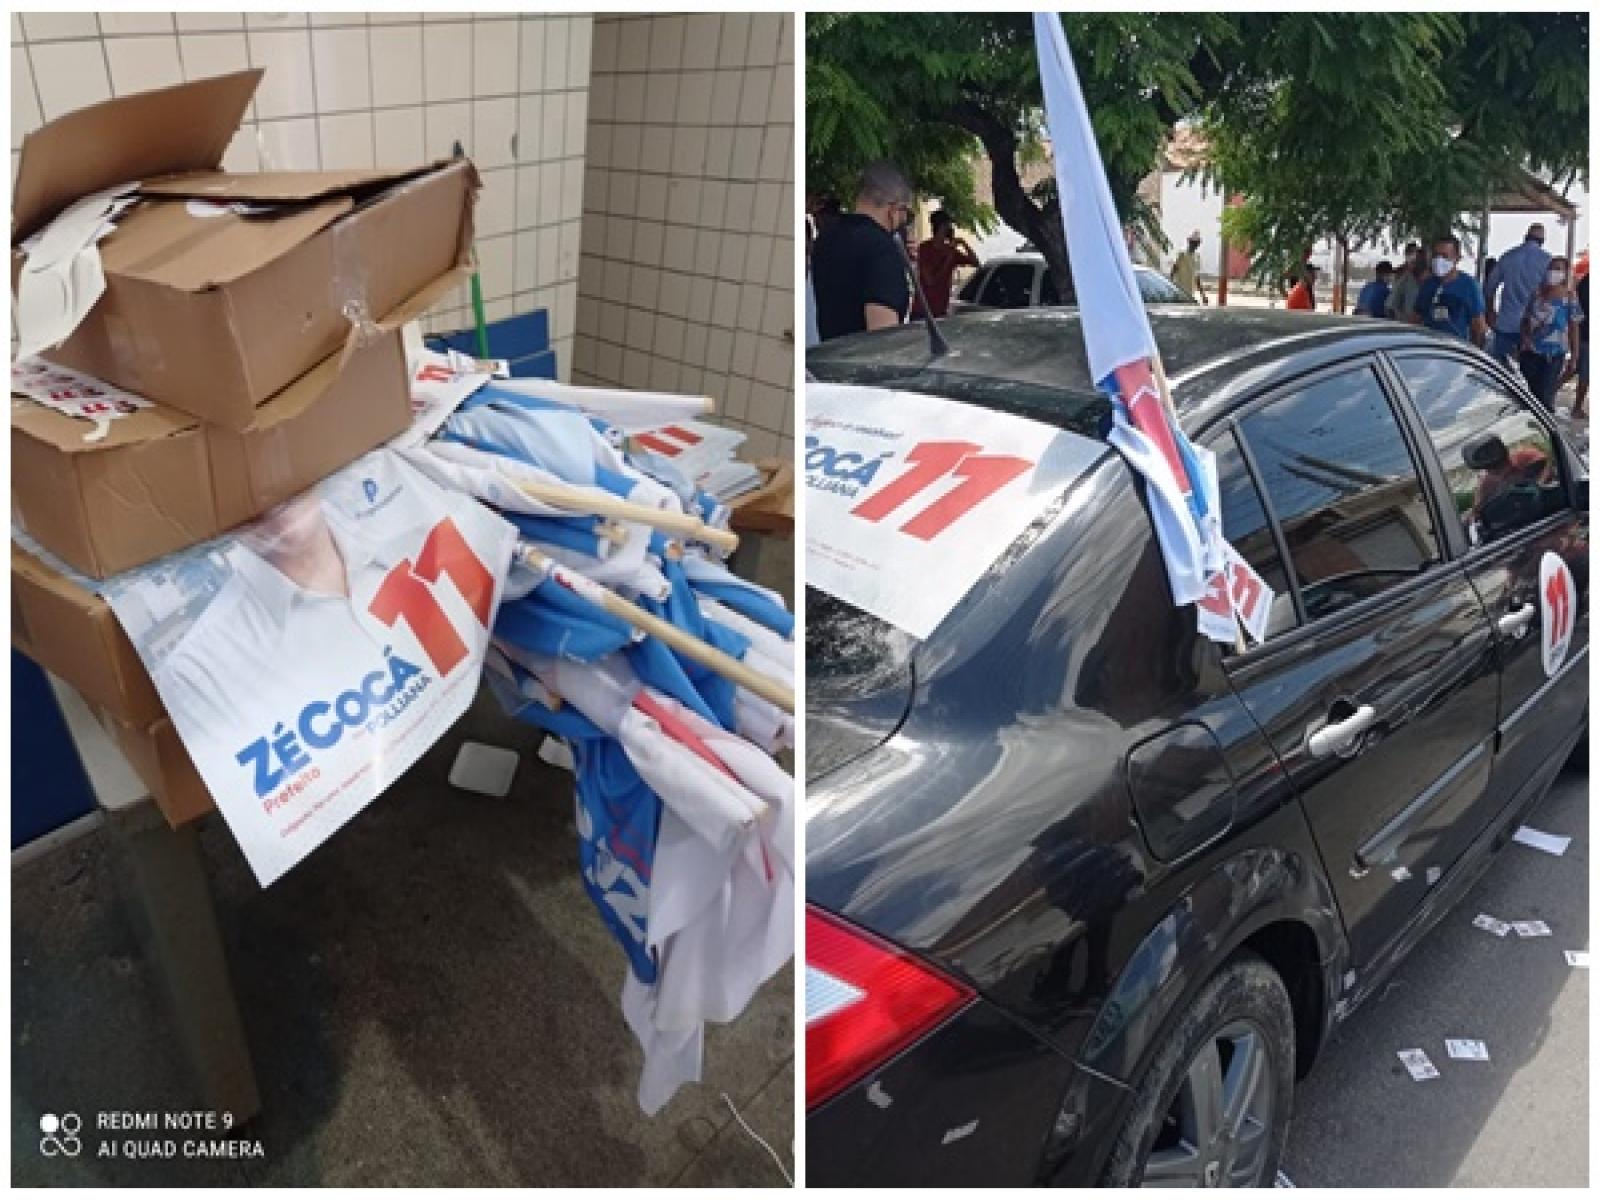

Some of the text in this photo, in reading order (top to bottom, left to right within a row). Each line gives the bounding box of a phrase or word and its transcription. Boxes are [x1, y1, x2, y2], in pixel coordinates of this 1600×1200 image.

[849, 440, 1035, 541] 11
[368, 515, 495, 678] 11
[1545, 565, 1569, 646] 11
